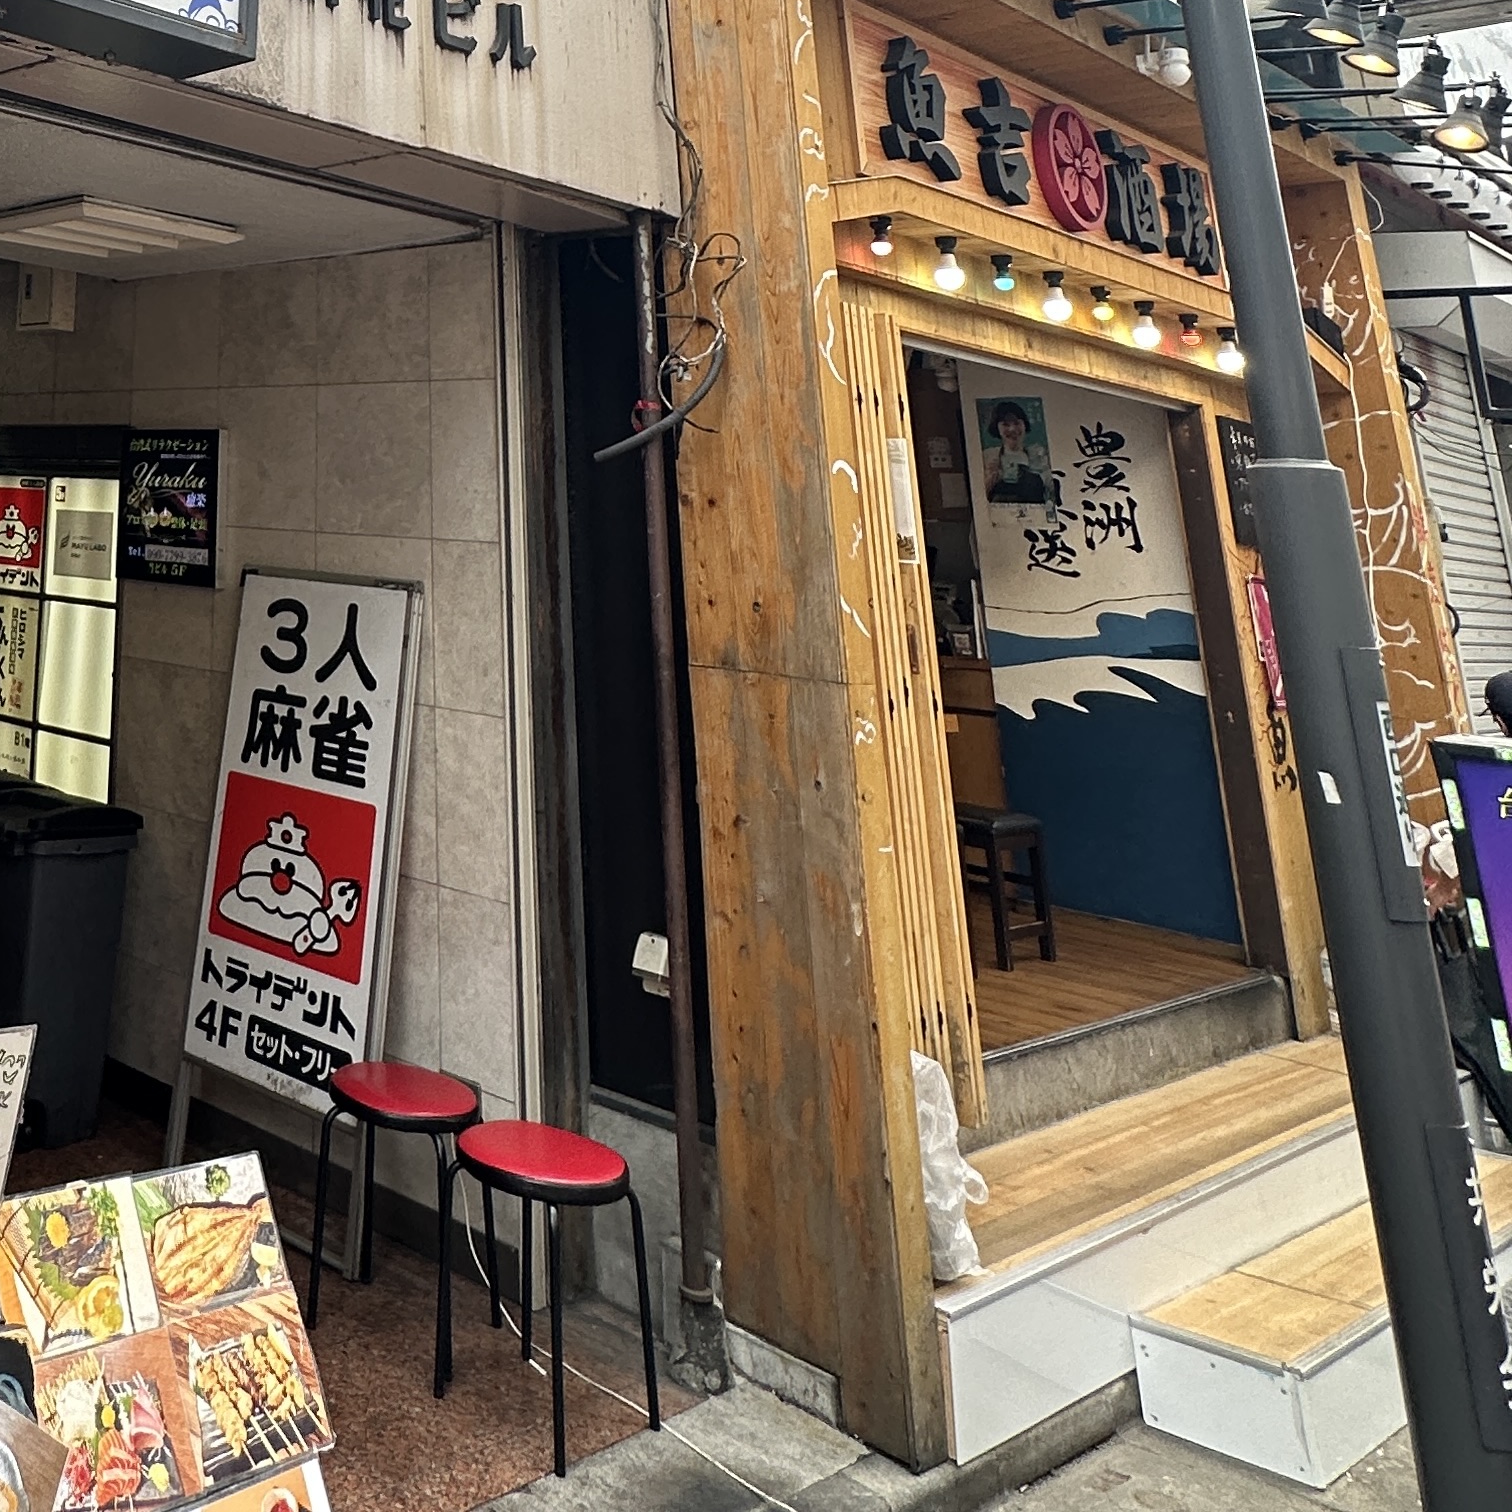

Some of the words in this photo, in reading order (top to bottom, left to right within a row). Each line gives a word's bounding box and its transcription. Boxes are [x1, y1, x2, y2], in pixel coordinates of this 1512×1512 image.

[133, 461, 208, 489] Yuraku
[1072, 421, 1144, 553] 豊洲
[17, 608, 27, 660] ヒロシマ
[260, 598, 377, 691] 3人
[241, 685, 374, 788] 麻雀
[194, 999, 243, 1049] 4F
[201, 947, 356, 1041] トライデント
